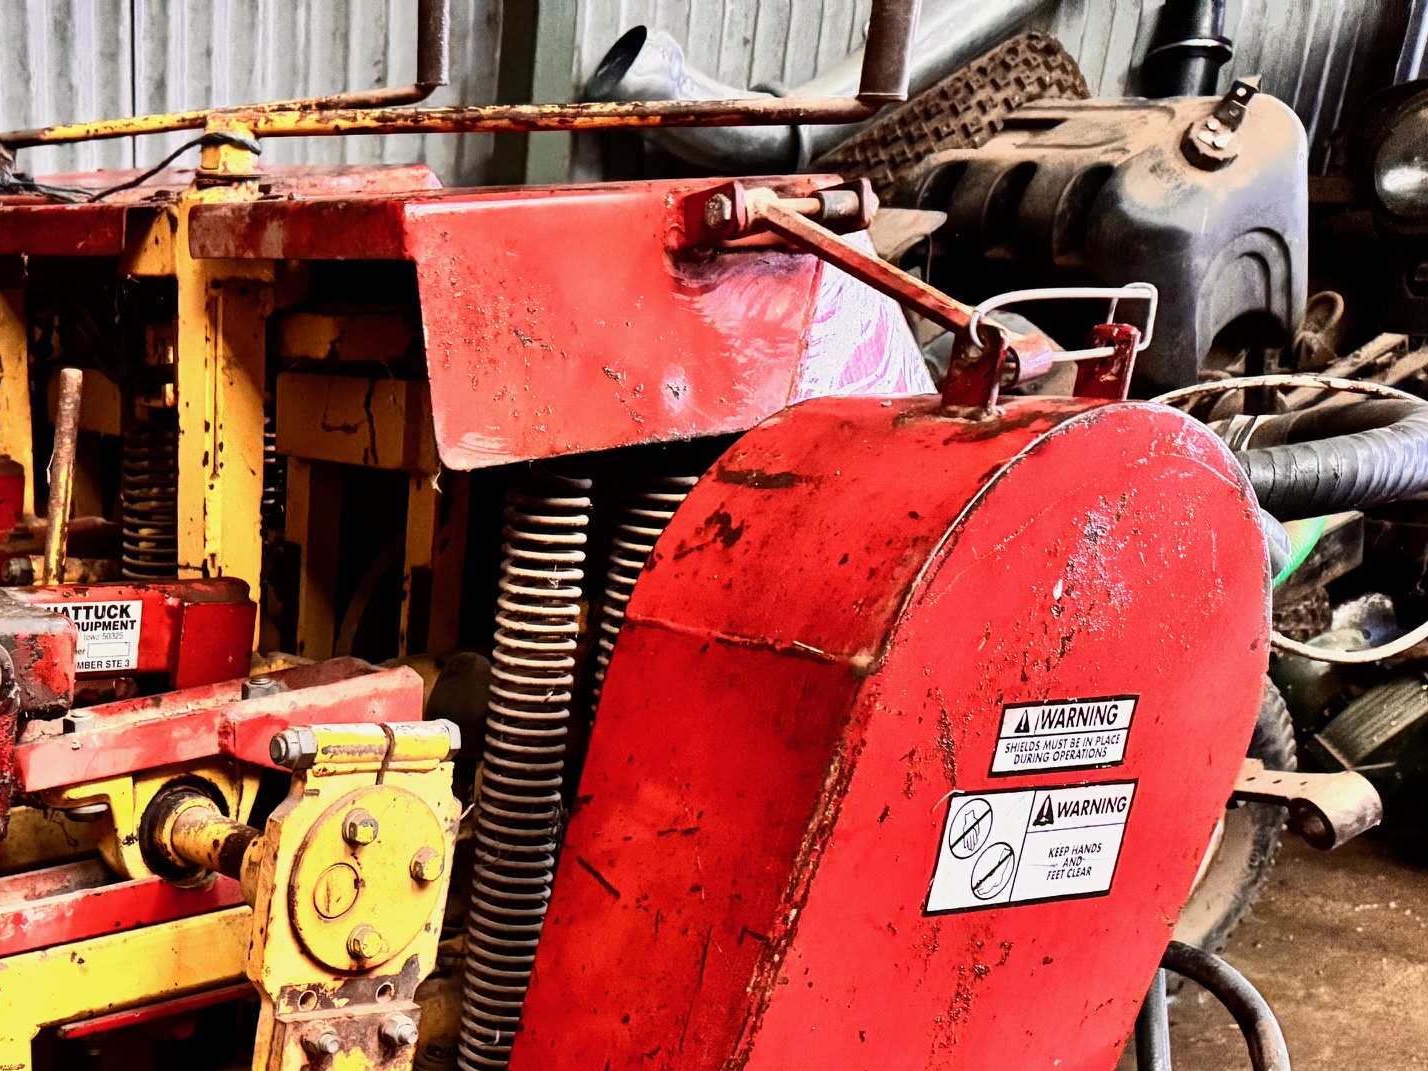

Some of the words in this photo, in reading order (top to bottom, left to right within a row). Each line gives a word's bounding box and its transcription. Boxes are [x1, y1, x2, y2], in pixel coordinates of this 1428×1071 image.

[47, 604, 131, 620] ATTUCK
[102, 632, 124, 640] 50325
[77, 661, 103, 669] MBER
[105, 660, 122, 668] STE
[125, 660, 130, 668] 3
[1040, 704, 1119, 730] WARNING
[1005, 740, 1041, 753] SHIELDS
[1043, 738, 1068, 750] MUST
[1070, 737, 1080, 748] BE
[1082, 736, 1094, 747] IN
[1095, 734, 1121, 746] PLACE
[1014, 752, 1050, 765] DURING
[1052, 747, 1108, 761] OPERATIONS
[1057, 796, 1128, 818] WARNING
[1048, 846, 1070, 858] KEEP
[1071, 843, 1103, 855] HANDS
[1062, 856, 1083, 867] AND
[1046, 869, 1066, 880] FEET
[1066, 867, 1092, 878] CLEAR
